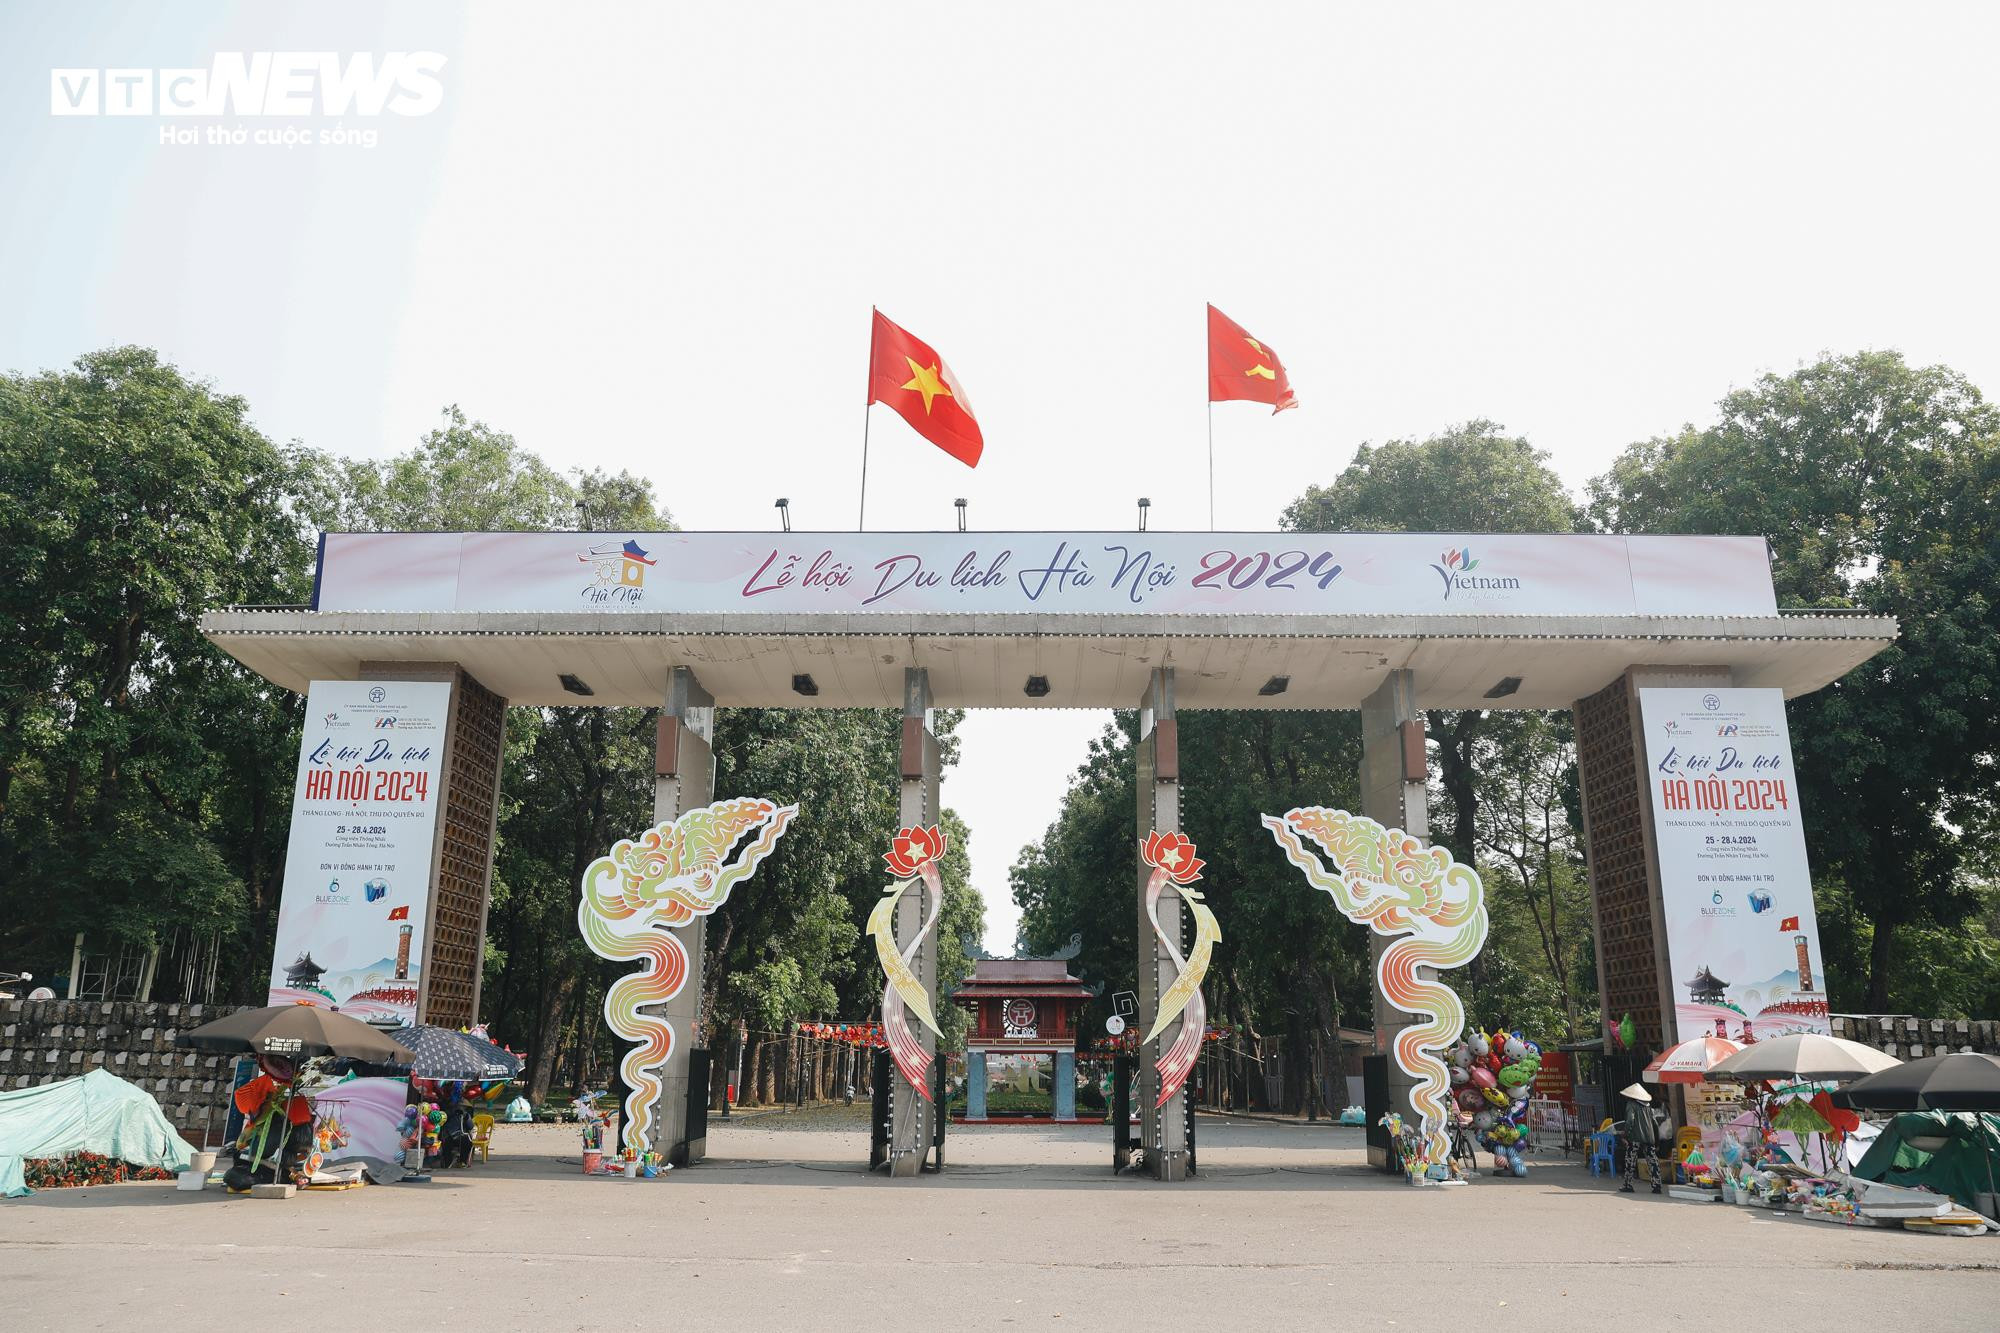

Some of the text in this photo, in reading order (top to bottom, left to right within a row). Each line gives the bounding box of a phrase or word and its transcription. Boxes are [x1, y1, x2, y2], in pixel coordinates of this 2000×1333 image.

[741, 541, 1343, 605] Lễ hội Du lịch Hà Nội 2024
[1429, 564, 1520, 601] Vietnam
[581, 586, 645, 605] Hà Nội
[308, 737, 430, 765] Lễ hội Du lịch
[1658, 746, 1783, 774] Lễ hội Du lịch
[305, 762, 428, 807] HÀ NỘI 2024
[1661, 771, 1788, 817] HÀ NỘI 2024
[336, 826, 345, 834] 25
[351, 826, 386, 834] 28.4.2024
[1705, 836, 1715, 844] 25
[1721, 836, 1756, 844] 28.4.2024
